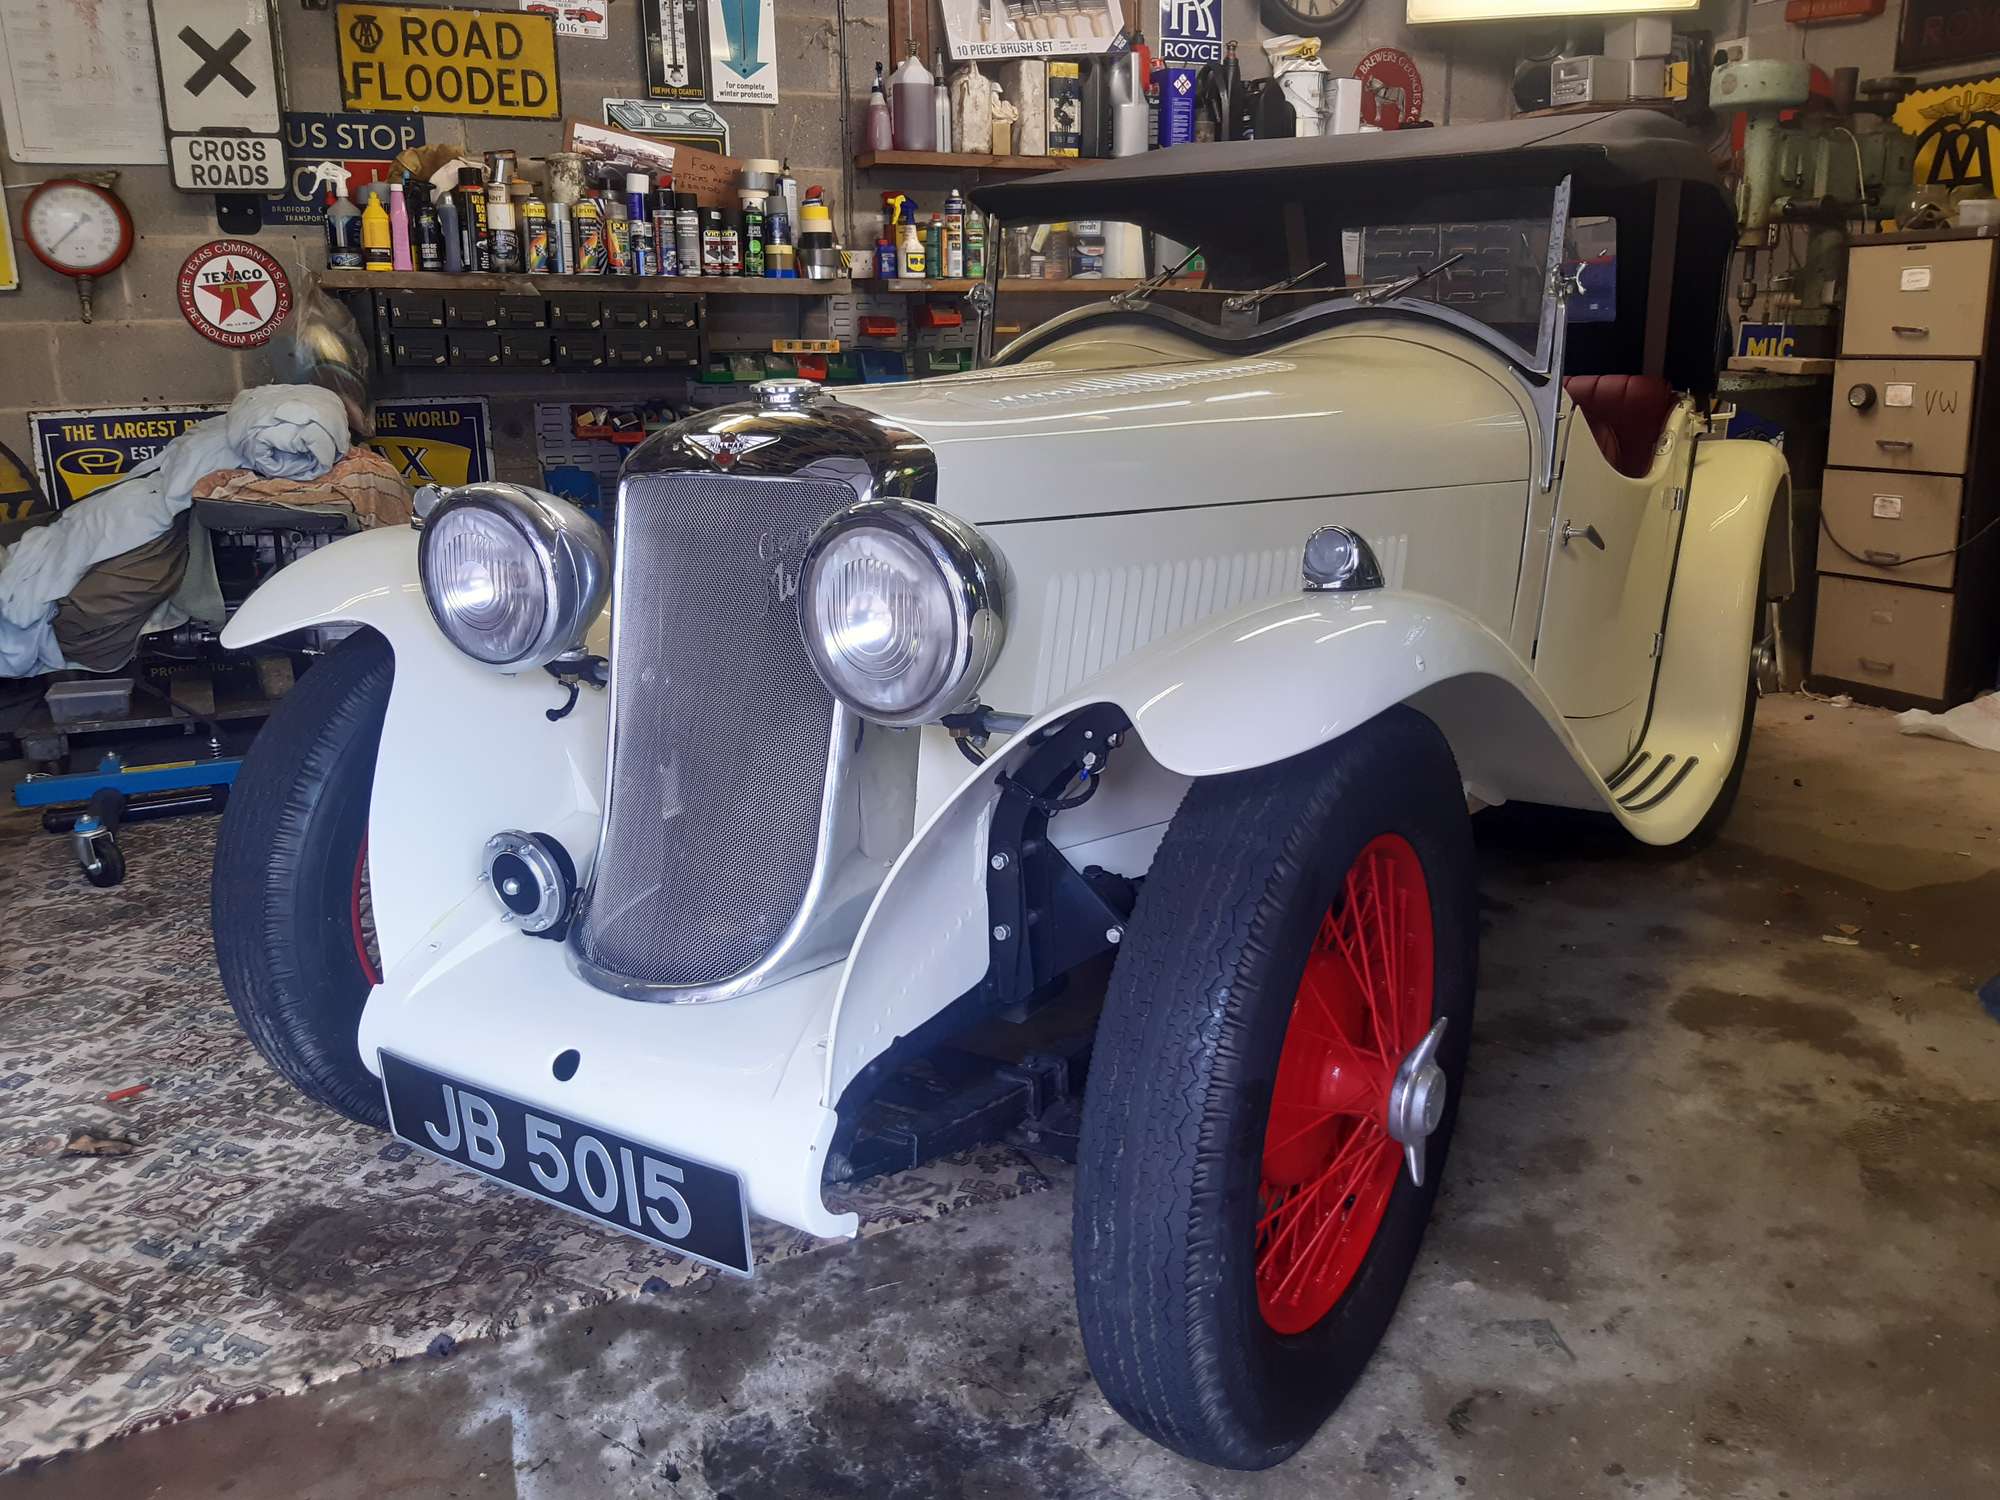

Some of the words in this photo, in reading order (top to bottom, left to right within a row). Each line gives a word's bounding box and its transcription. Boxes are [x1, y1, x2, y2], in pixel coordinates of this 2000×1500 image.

[557, 22, 577, 33] 016
[401, 17, 523, 61] ROAD
[957, 46, 968, 57] 10
[970, 43, 998, 56] PIECE
[1000, 42, 1033, 55] BRUSH
[1036, 41, 1053, 52] SET
[1164, 42, 1219, 60] ROYCE
[352, 62, 549, 107] FLOODED
[719, 90, 740, 98] winter
[741, 90, 773, 100] protection
[726, 81, 735, 90] for
[736, 82, 765, 92] complete
[286, 123, 328, 148] US
[336, 123, 416, 150] STOP
[189, 140, 266, 162] CROSS
[191, 165, 270, 187] ROADS
[185, 248, 213, 275] TEXAS
[214, 243, 269, 264] COMPANY
[203, 268, 263, 284] TEXACO
[180, 279, 192, 298] THE
[218, 283, 249, 310] T
[186, 307, 246, 344] PETROLEUM
[250, 299, 289, 343] PRODUCTS
[1925, 389, 1958, 416] VW
[375, 412, 397, 429] HE
[403, 410, 461, 428] WORLD
[61, 424, 97, 442] THE
[103, 420, 177, 440] LARGEST
[131, 446, 157, 461] EST
[424, 1083, 506, 1171] JB
[525, 1113, 692, 1240] 5015
